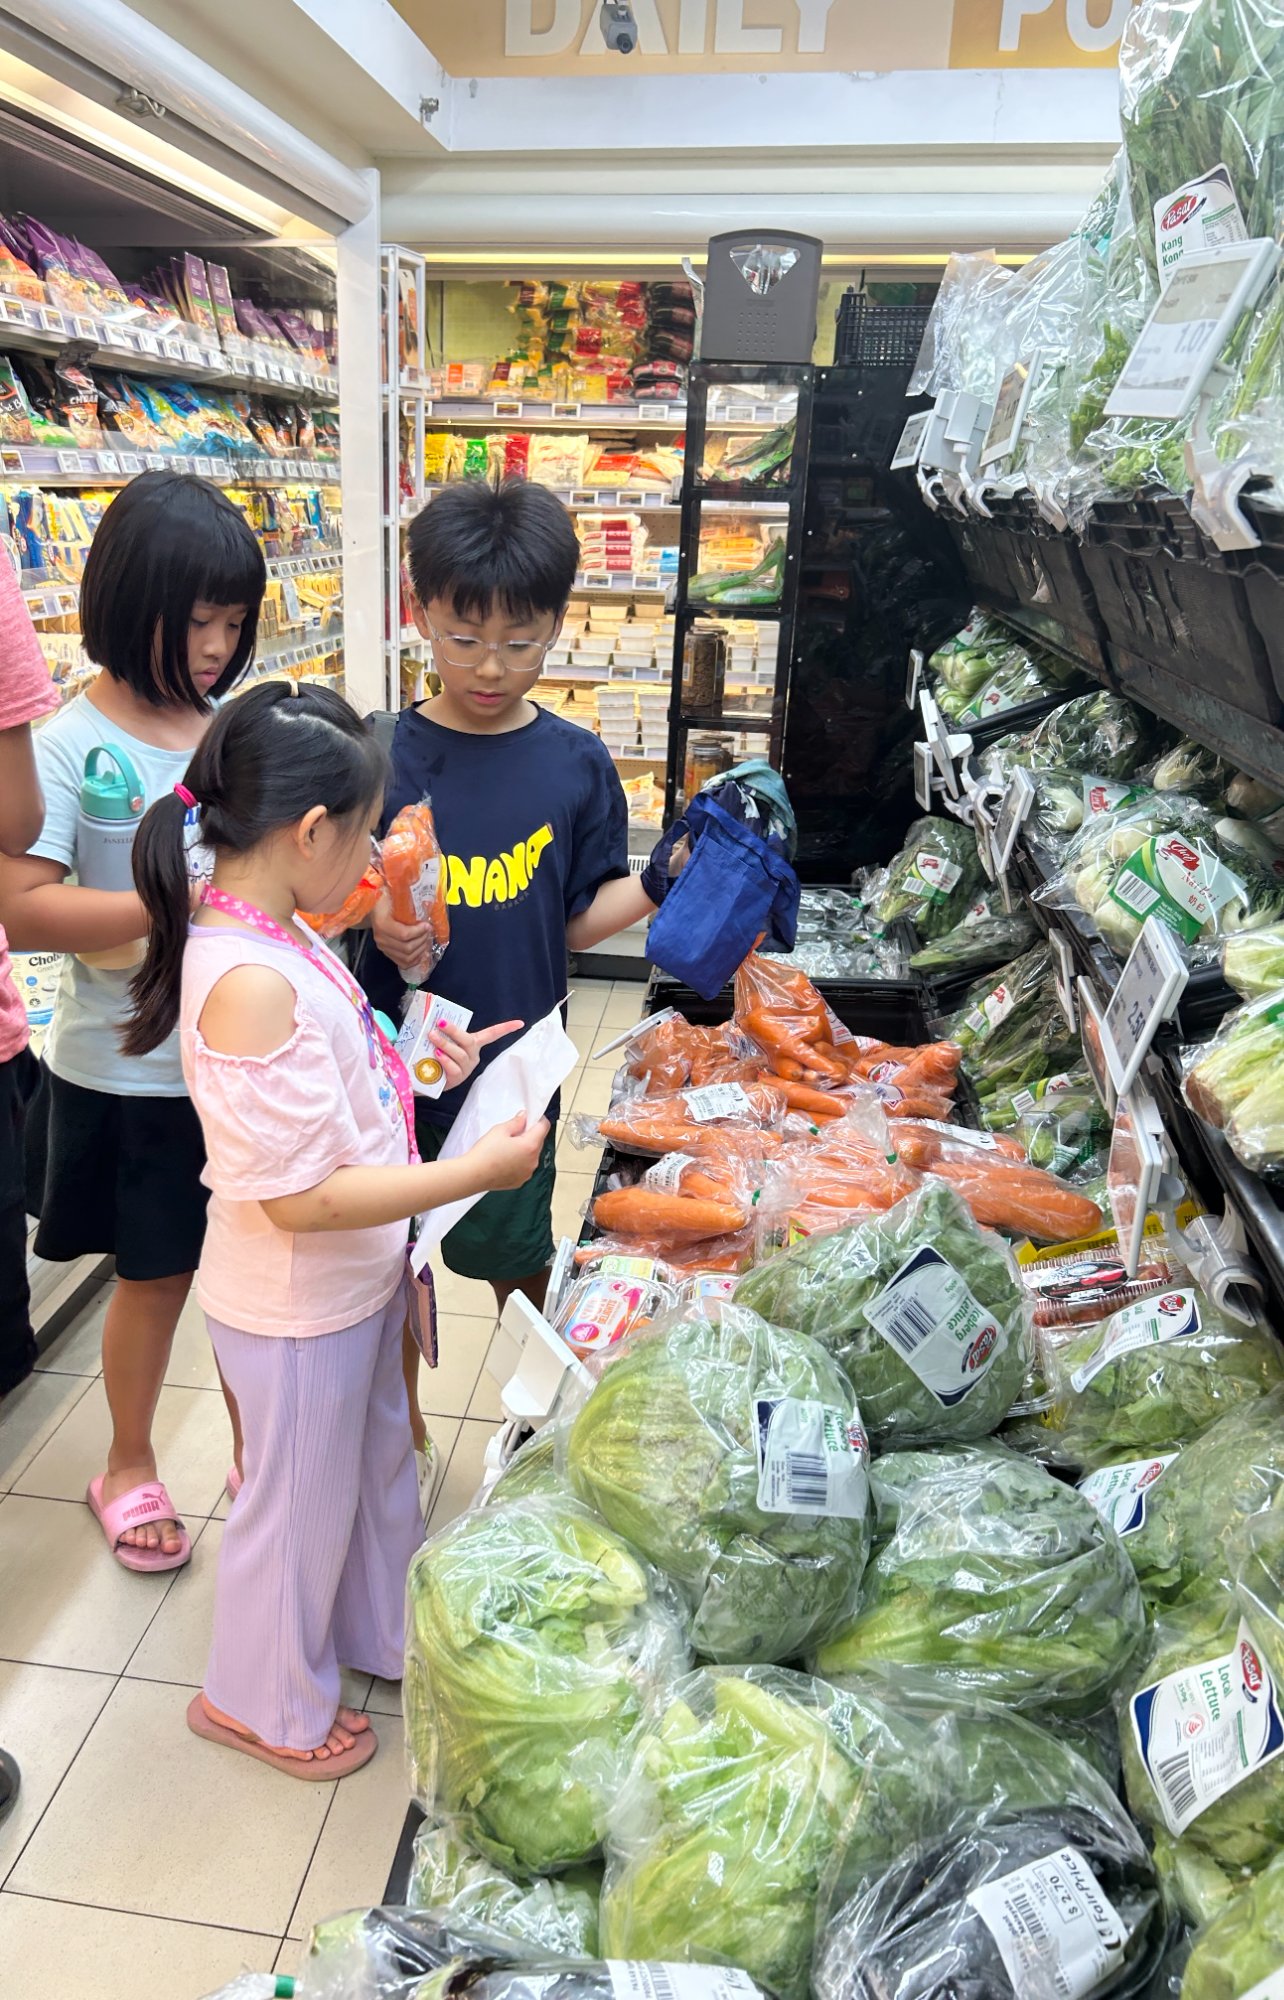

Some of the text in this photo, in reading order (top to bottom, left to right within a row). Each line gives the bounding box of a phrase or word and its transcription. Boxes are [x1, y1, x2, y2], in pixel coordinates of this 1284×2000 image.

[1161, 234, 1183, 253] Kang
[947, 1297, 974, 1330] Lettuce
[956, 1308, 986, 1342] Iceberg
[823, 1408, 839, 1451] Lettuce
[122, 1500, 161, 1522] PUMA
[1217, 1663, 1235, 1698] Local
[1240, 1646, 1261, 1686] Pasar
[1199, 1670, 1221, 1723] Lettuce
[1050, 1874, 1072, 1904] 2.70
[1060, 1853, 1110, 1924] FairPrice
